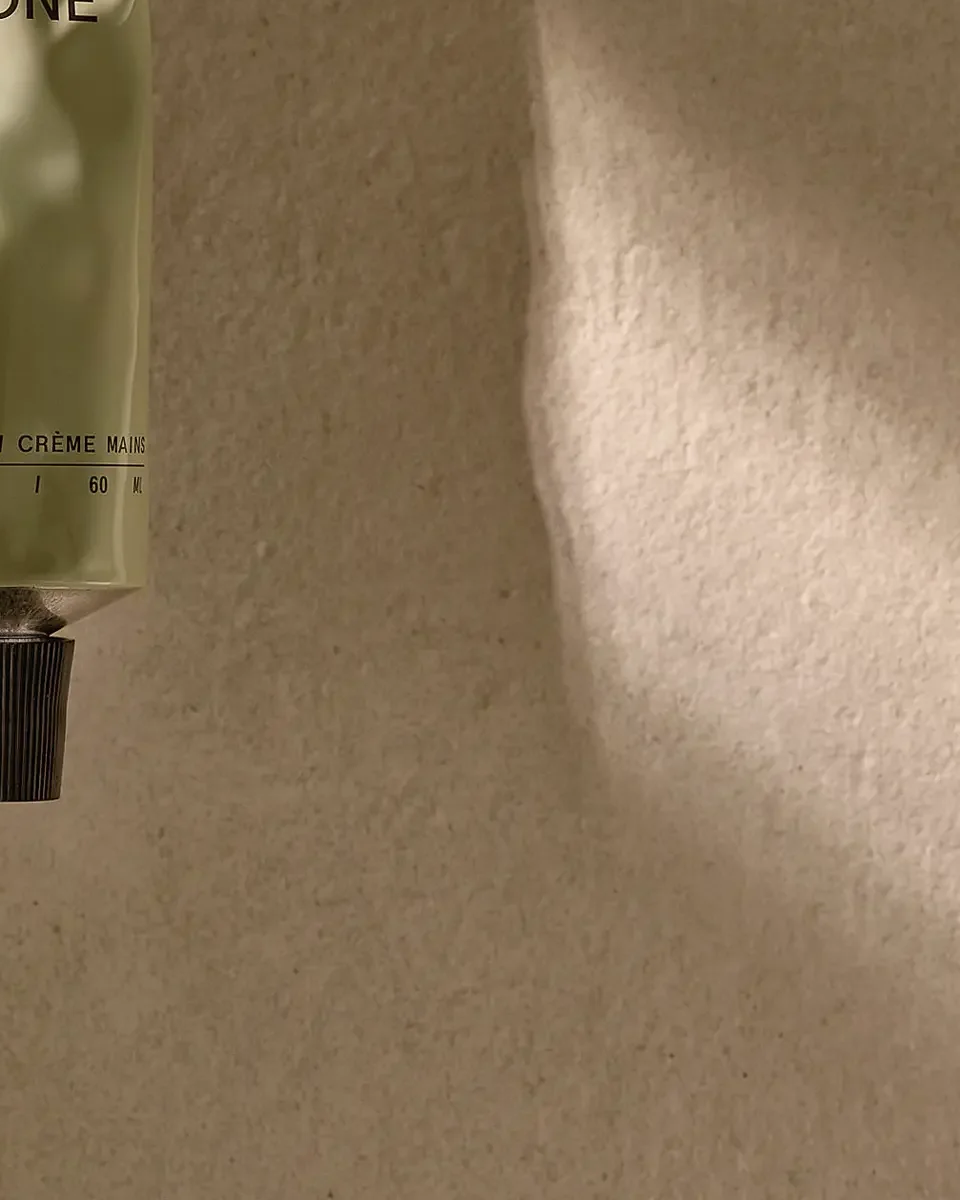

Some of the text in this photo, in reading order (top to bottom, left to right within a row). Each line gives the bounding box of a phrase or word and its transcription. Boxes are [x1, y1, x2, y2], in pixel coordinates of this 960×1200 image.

[17, 430, 96, 453] CRÈME
[107, 435, 146, 454] MAINS
[89, 475, 108, 494] 60
